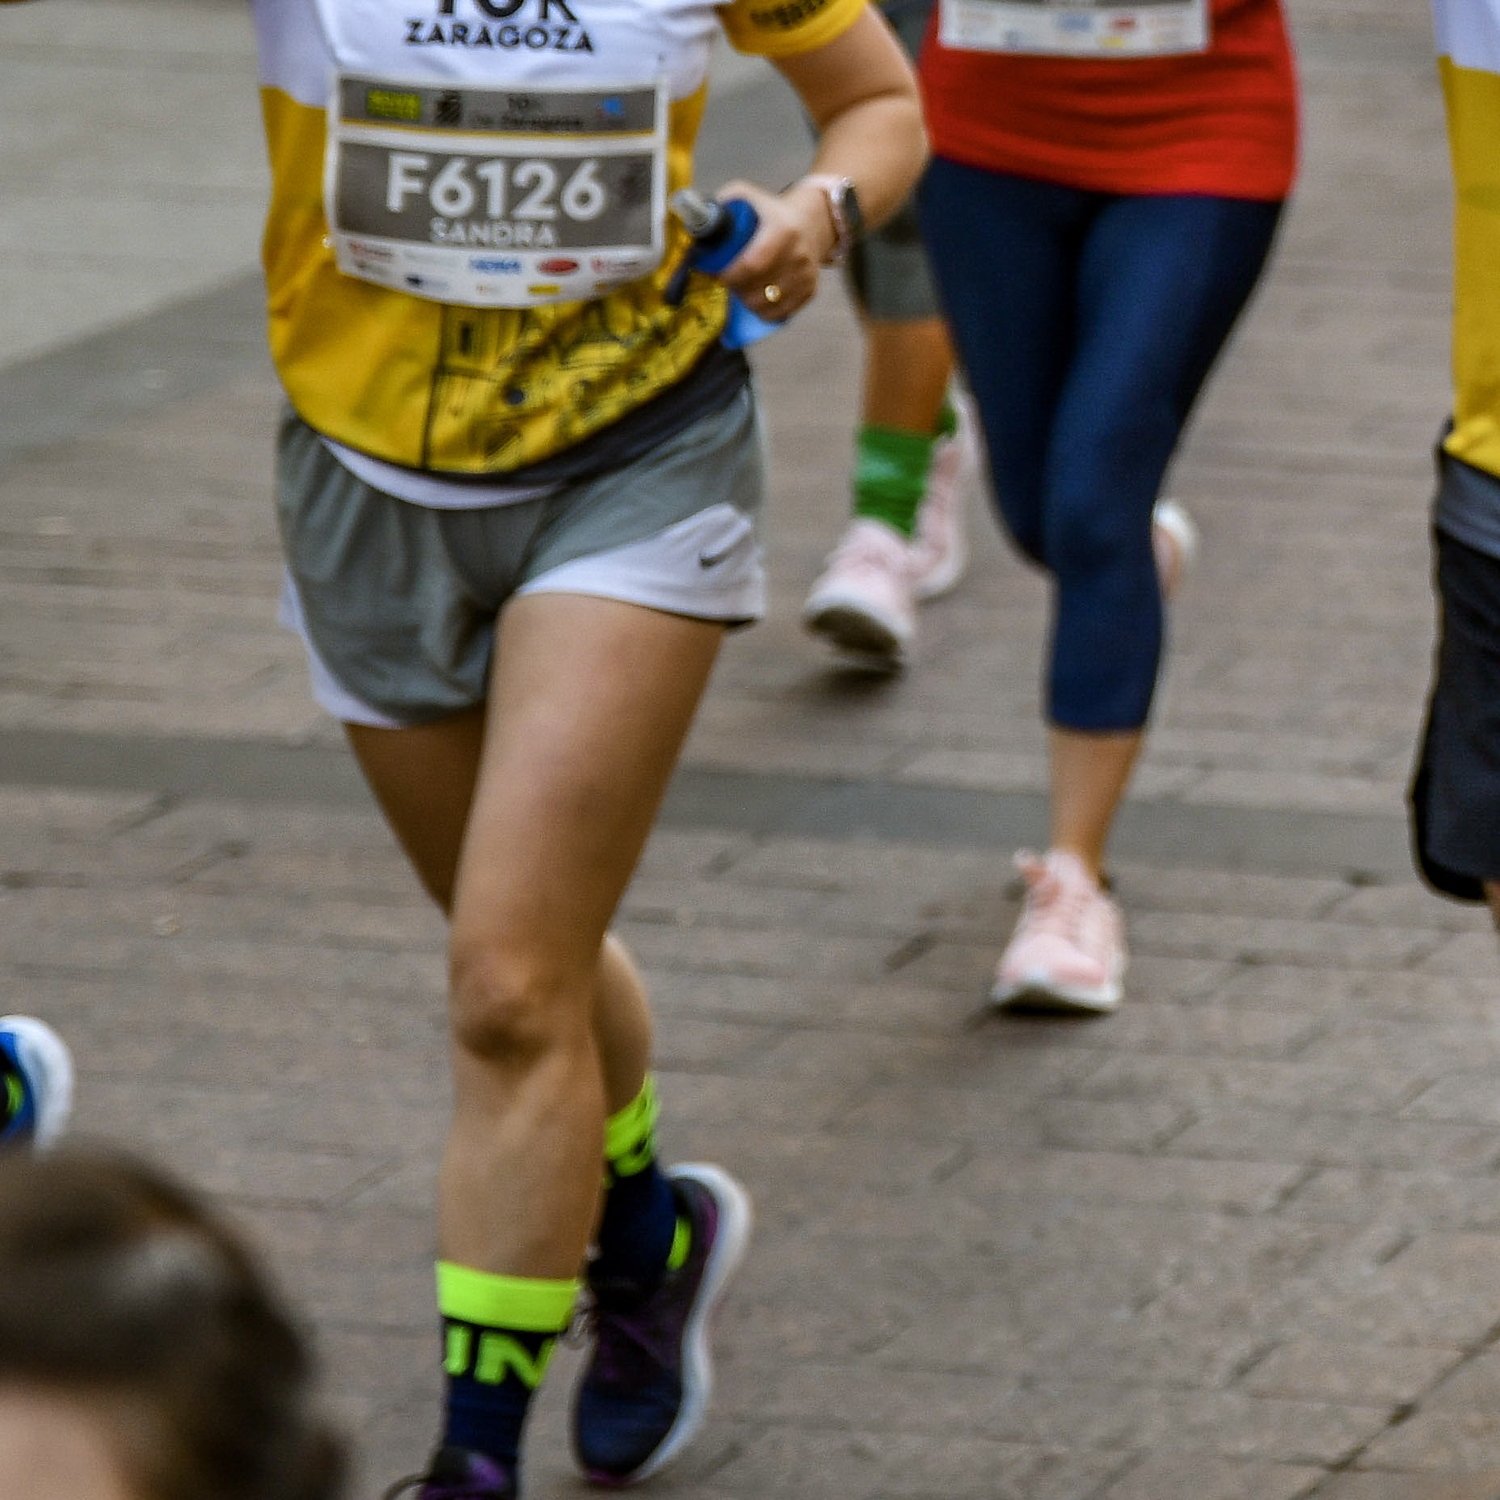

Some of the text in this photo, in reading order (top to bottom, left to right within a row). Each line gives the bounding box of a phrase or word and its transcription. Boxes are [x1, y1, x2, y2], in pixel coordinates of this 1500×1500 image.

[404, 20, 594, 54] ZARAGOZA
[386, 151, 605, 222] F6126
[430, 216, 556, 247] SANDRA
